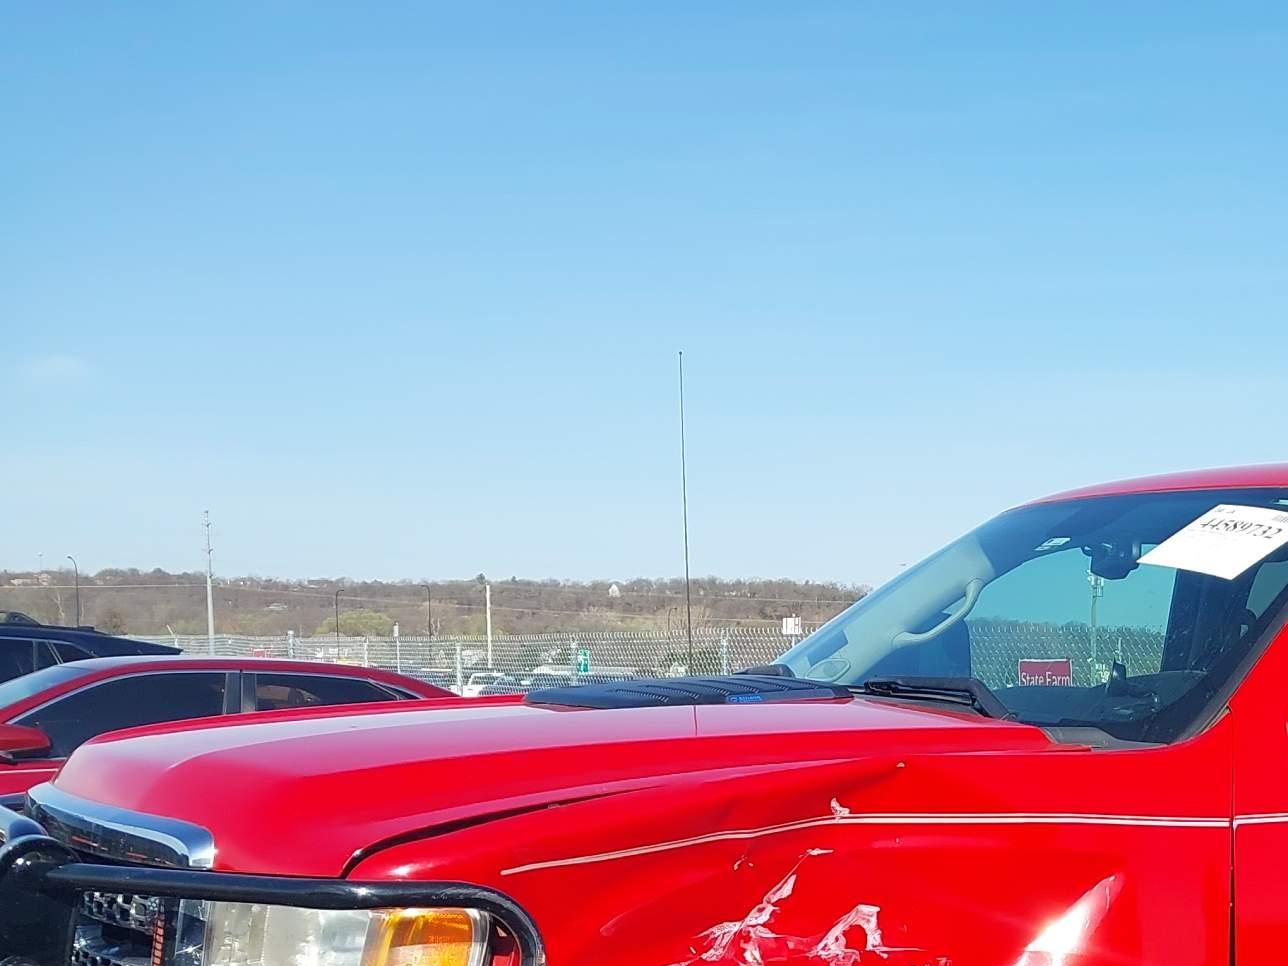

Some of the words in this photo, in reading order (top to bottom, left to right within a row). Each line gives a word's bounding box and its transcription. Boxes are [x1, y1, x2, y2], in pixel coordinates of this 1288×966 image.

[1199, 517, 1283, 540] 44589732
[1021, 671, 1044, 686] State
[1045, 671, 1070, 686] Farm
